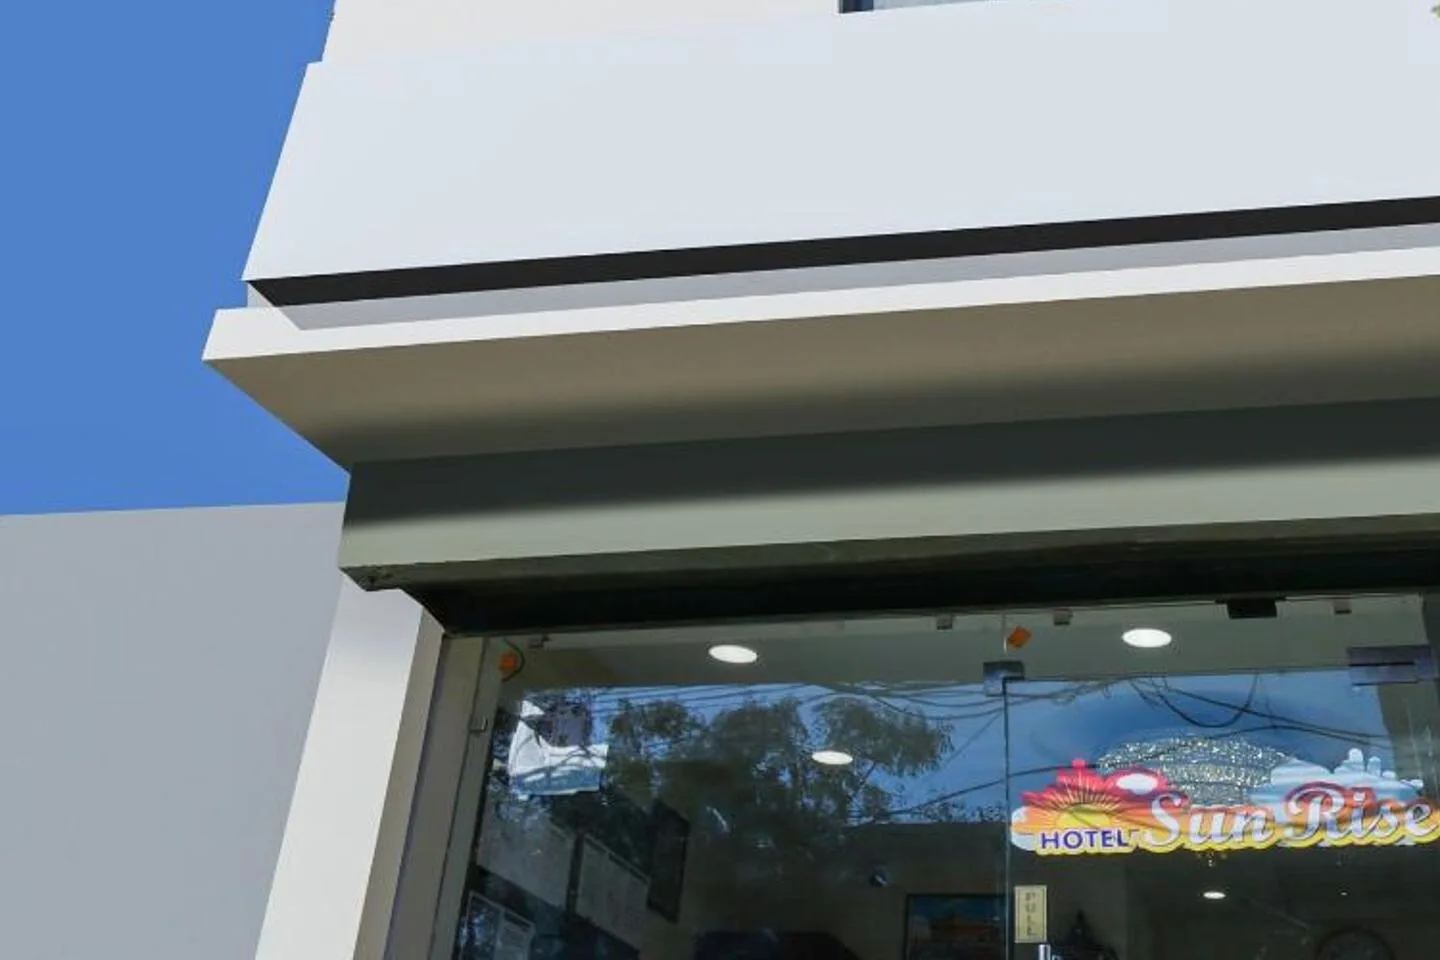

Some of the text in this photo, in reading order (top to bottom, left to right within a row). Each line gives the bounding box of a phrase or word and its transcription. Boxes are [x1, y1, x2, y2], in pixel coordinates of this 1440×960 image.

[1040, 786, 1437, 850] HOTEL Sun Rise
